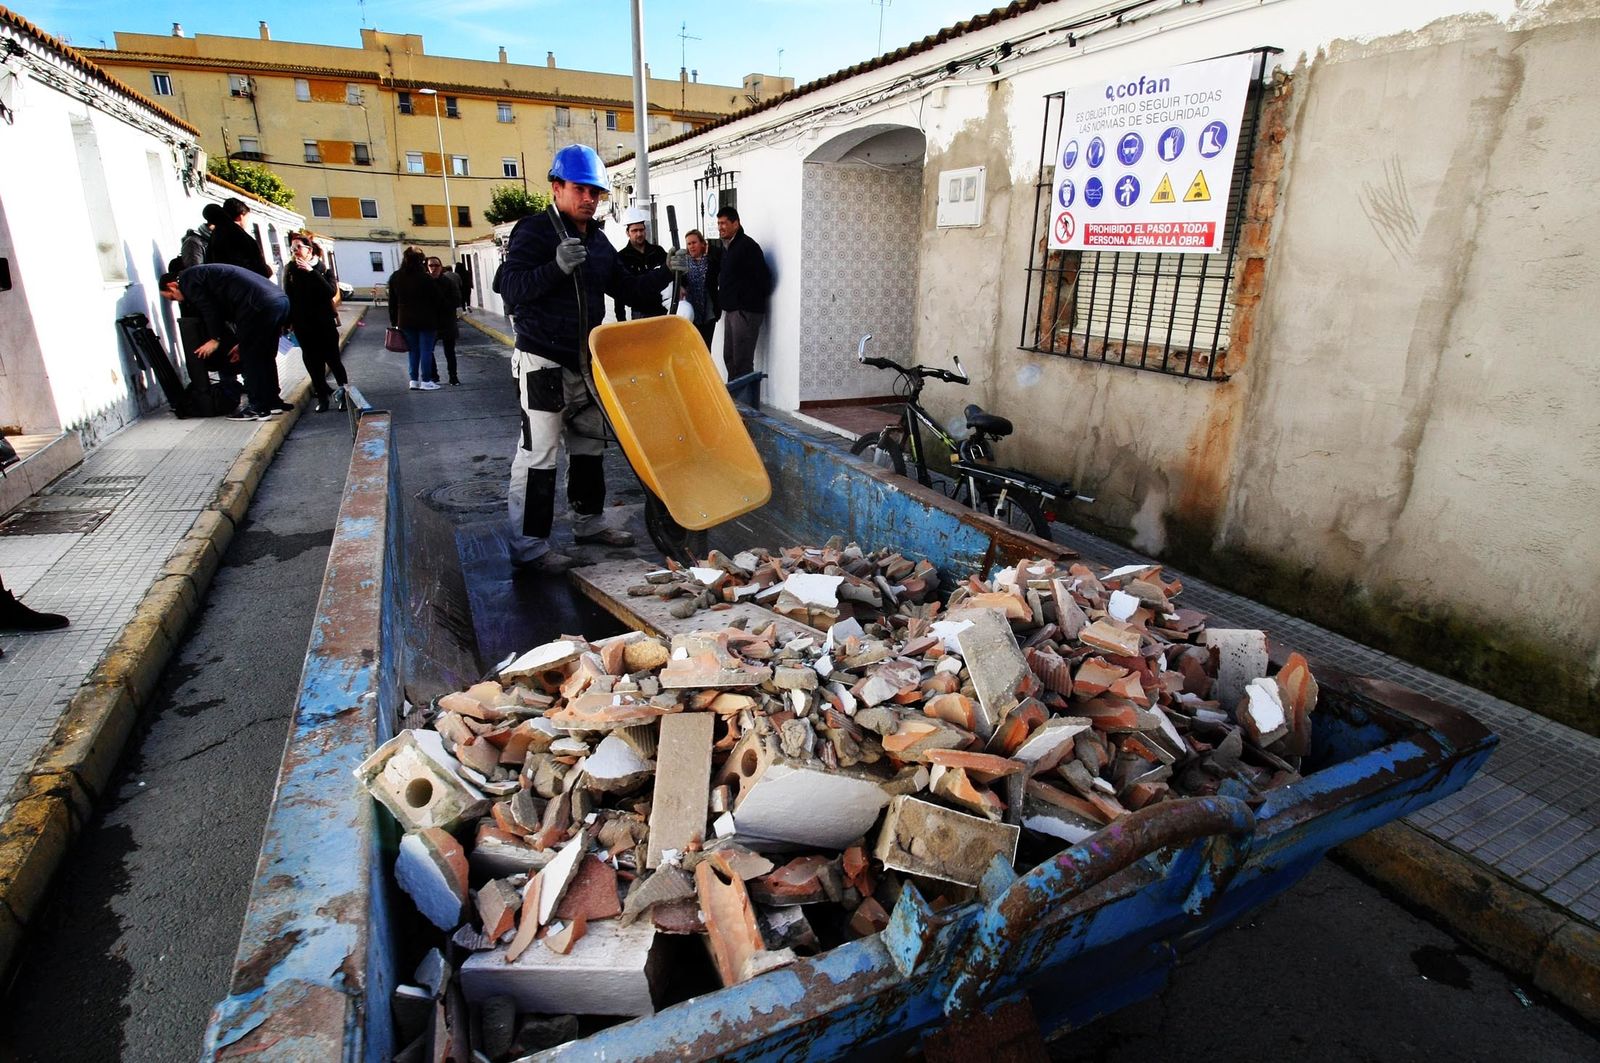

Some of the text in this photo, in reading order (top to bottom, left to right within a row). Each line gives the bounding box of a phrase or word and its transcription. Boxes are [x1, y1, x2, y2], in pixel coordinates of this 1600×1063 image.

[1116, 75, 1170, 98] cofan
[1076, 89, 1222, 123] ES OBLIGATORIO SEGUIR TODAS
[1079, 106, 1210, 134] LAS NORMAS DE SEGURIDAD
[1089, 223, 1208, 234] PROHIBIDO EL PASO A TODA
[1089, 235, 1206, 246] PERSONA AJENA A LA OBRA
